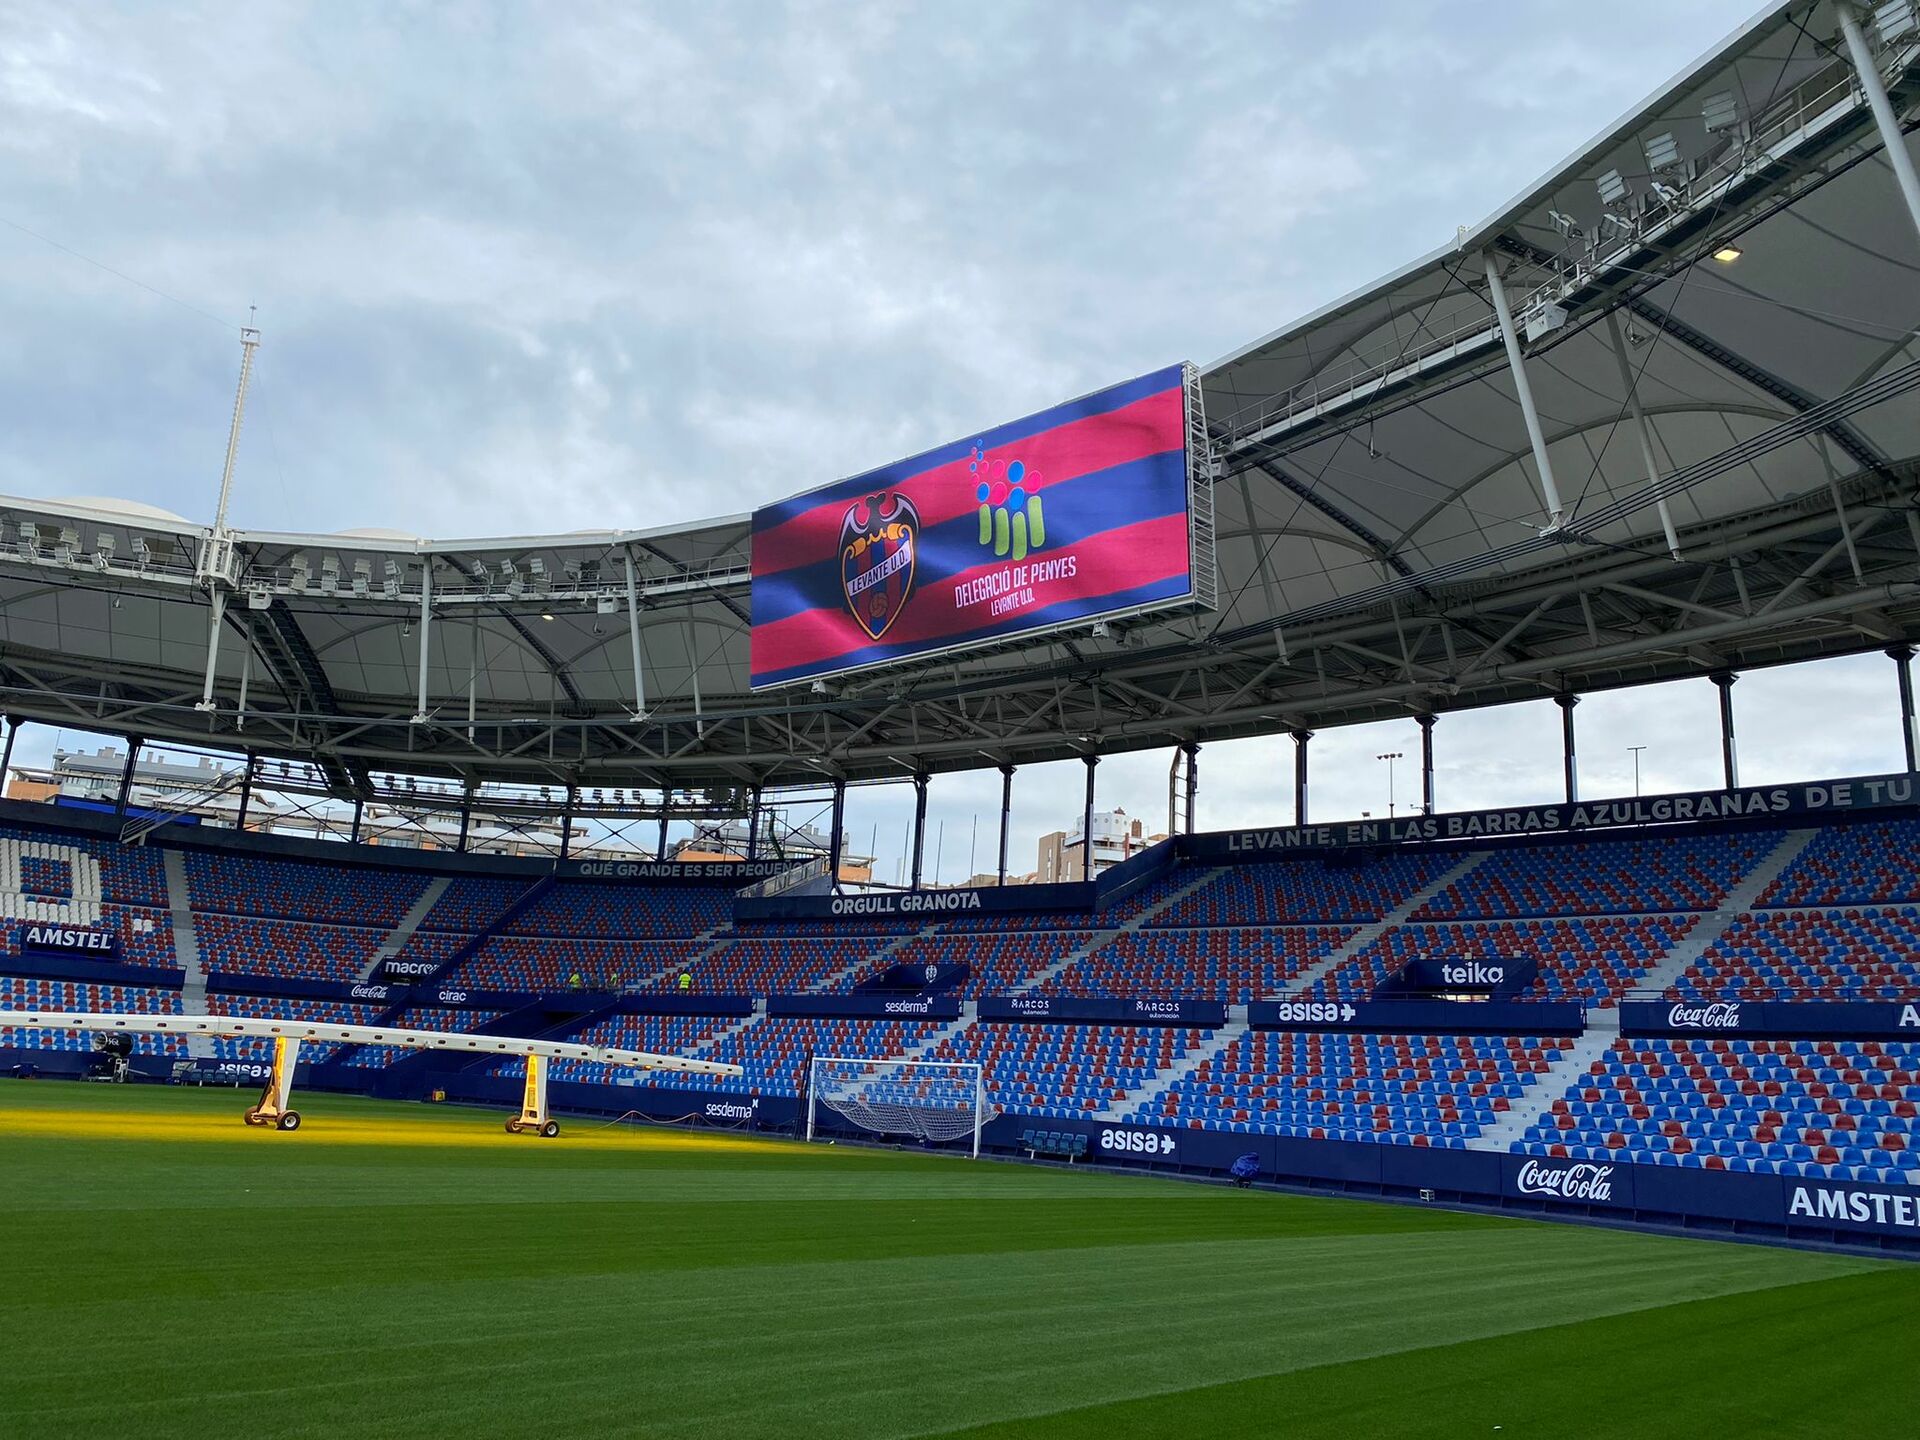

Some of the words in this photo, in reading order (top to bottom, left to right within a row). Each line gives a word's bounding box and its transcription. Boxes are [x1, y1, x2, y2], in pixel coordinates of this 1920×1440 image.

[852, 561, 889, 593] LEVANTE
[890, 549, 908, 571] U.D.
[955, 566, 1011, 608] DELEGACIÓ
[1013, 566, 1028, 588] DE
[1031, 556, 1077, 583] PENYES
[991, 592, 1020, 616] LEVANTE
[1021, 587, 1035, 605] U.D.
[1228, 826, 1336, 851] LEVANTE,
[1347, 823, 1378, 842] EN
[1389, 819, 1438, 840] LAS
[1447, 808, 1560, 835] BARRAS
[1570, 789, 1790, 827] AZULGRANAS
[1805, 784, 1851, 809] DE
[1864, 778, 1912, 803] TU
[580, 861, 613, 876] QUÉ
[617, 864, 681, 877] GRANDE
[684, 864, 702, 877] ES
[705, 863, 732, 877] SER
[831, 897, 895, 915] ORGULL
[900, 891, 981, 912] GRANOTA
[26, 927, 112, 950] AMSTEL
[1441, 961, 1504, 984] teika
[439, 990, 467, 1001] cirac
[885, 1000, 929, 1013] sesderma
[1011, 999, 1050, 1009] MARCOS
[1136, 1001, 1180, 1012] MARCOS
[1279, 1002, 1338, 1022] asisa
[1668, 1003, 1740, 1028] Coca-Cola
[705, 1101, 752, 1118] sesderma
[1101, 1129, 1158, 1154] asisa
[1516, 1159, 1614, 1201] Coca-Cola
